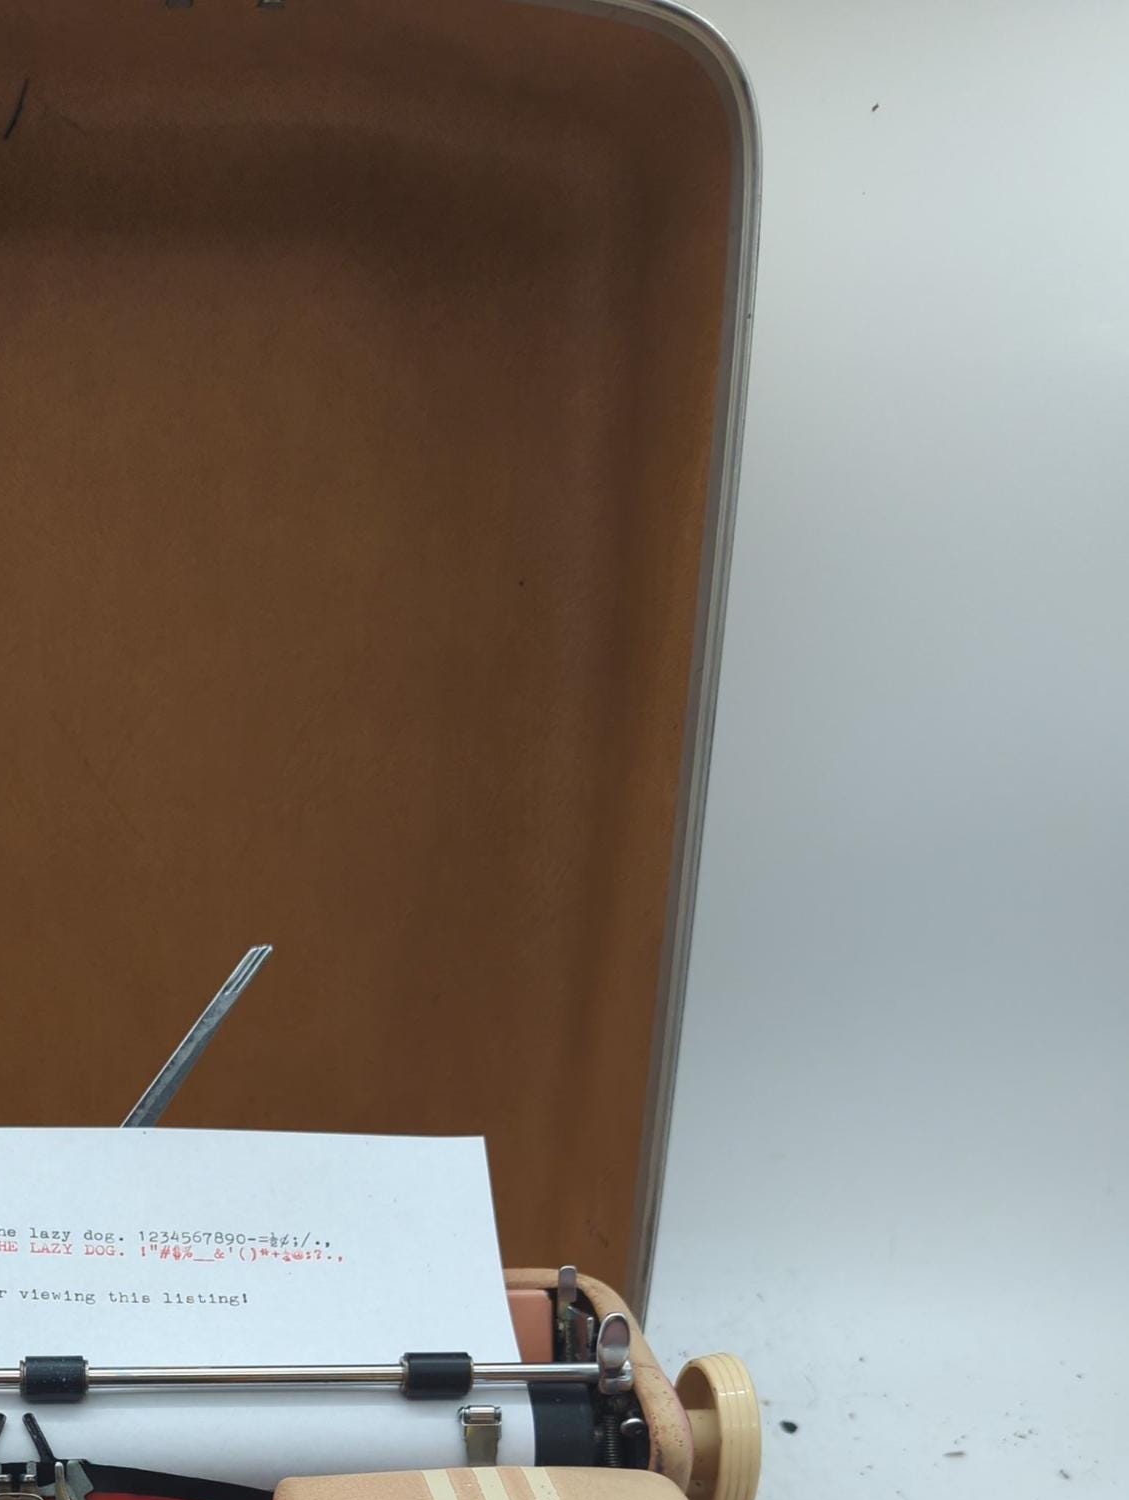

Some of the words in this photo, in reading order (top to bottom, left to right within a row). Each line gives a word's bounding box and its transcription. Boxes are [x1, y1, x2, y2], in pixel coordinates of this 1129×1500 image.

[29, 1227, 71, 1243] lazy
[83, 1229, 124, 1244] dog.
[29, 1242, 73, 1255] LAZY
[84, 1244, 125, 1257] DOG.
[19, 1289, 96, 1305] viewing
[108, 1291, 151, 1304] this
[162, 1292, 249, 1307] listing!
